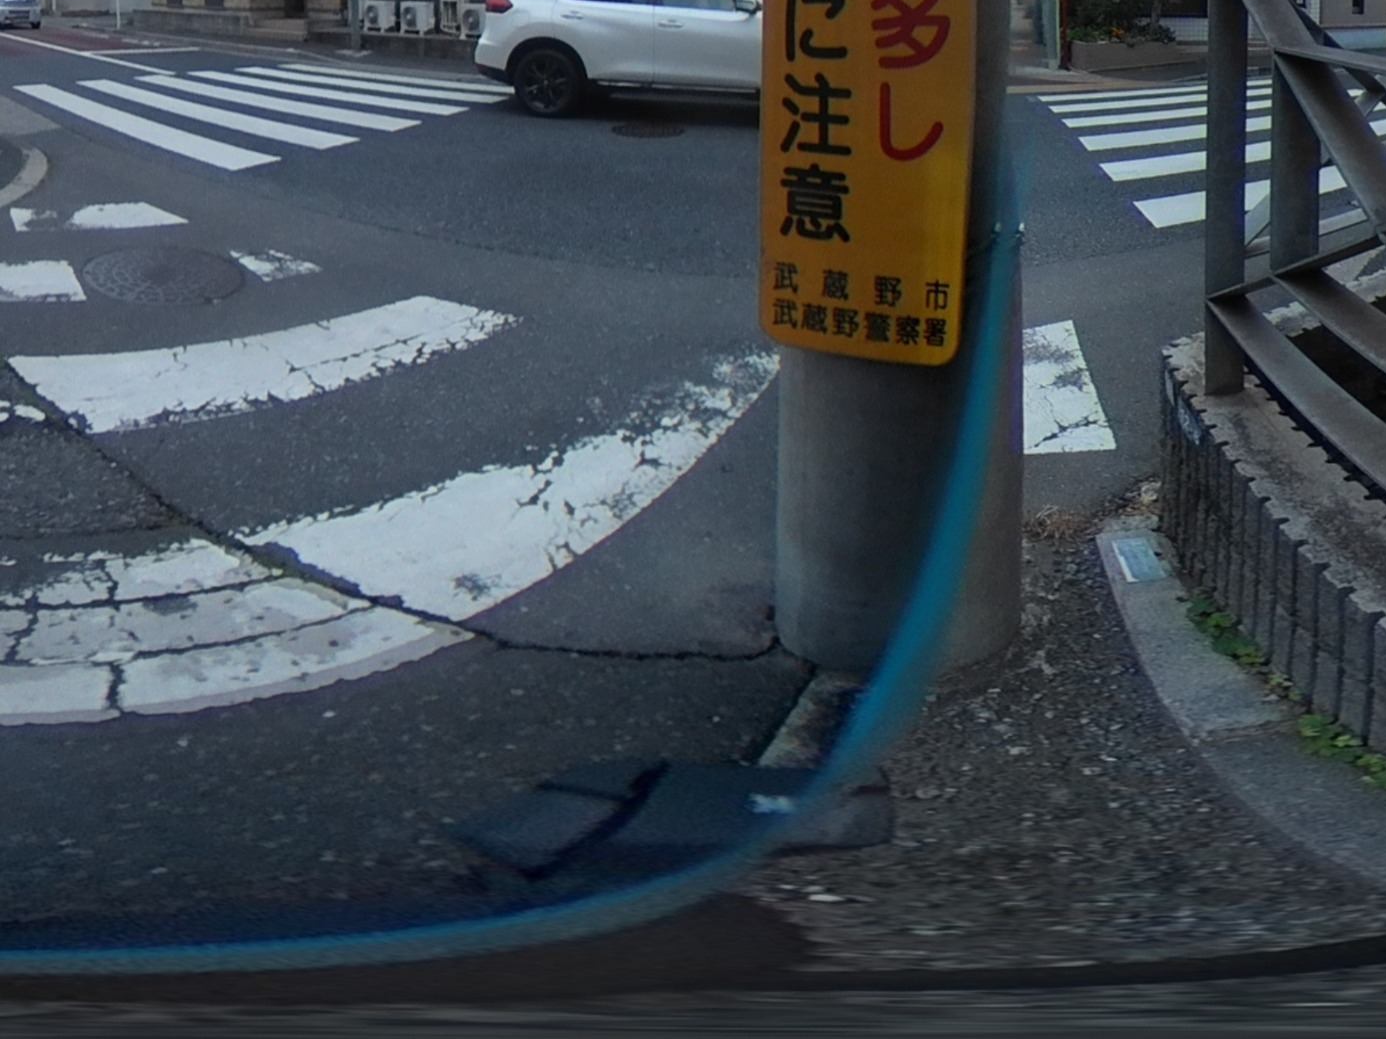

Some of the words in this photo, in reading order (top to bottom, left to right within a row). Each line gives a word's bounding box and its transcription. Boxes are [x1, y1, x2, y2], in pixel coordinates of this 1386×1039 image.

[773, 262, 950, 311] 武蔵野市
[773, 298, 947, 347] 武蔵野警察署
